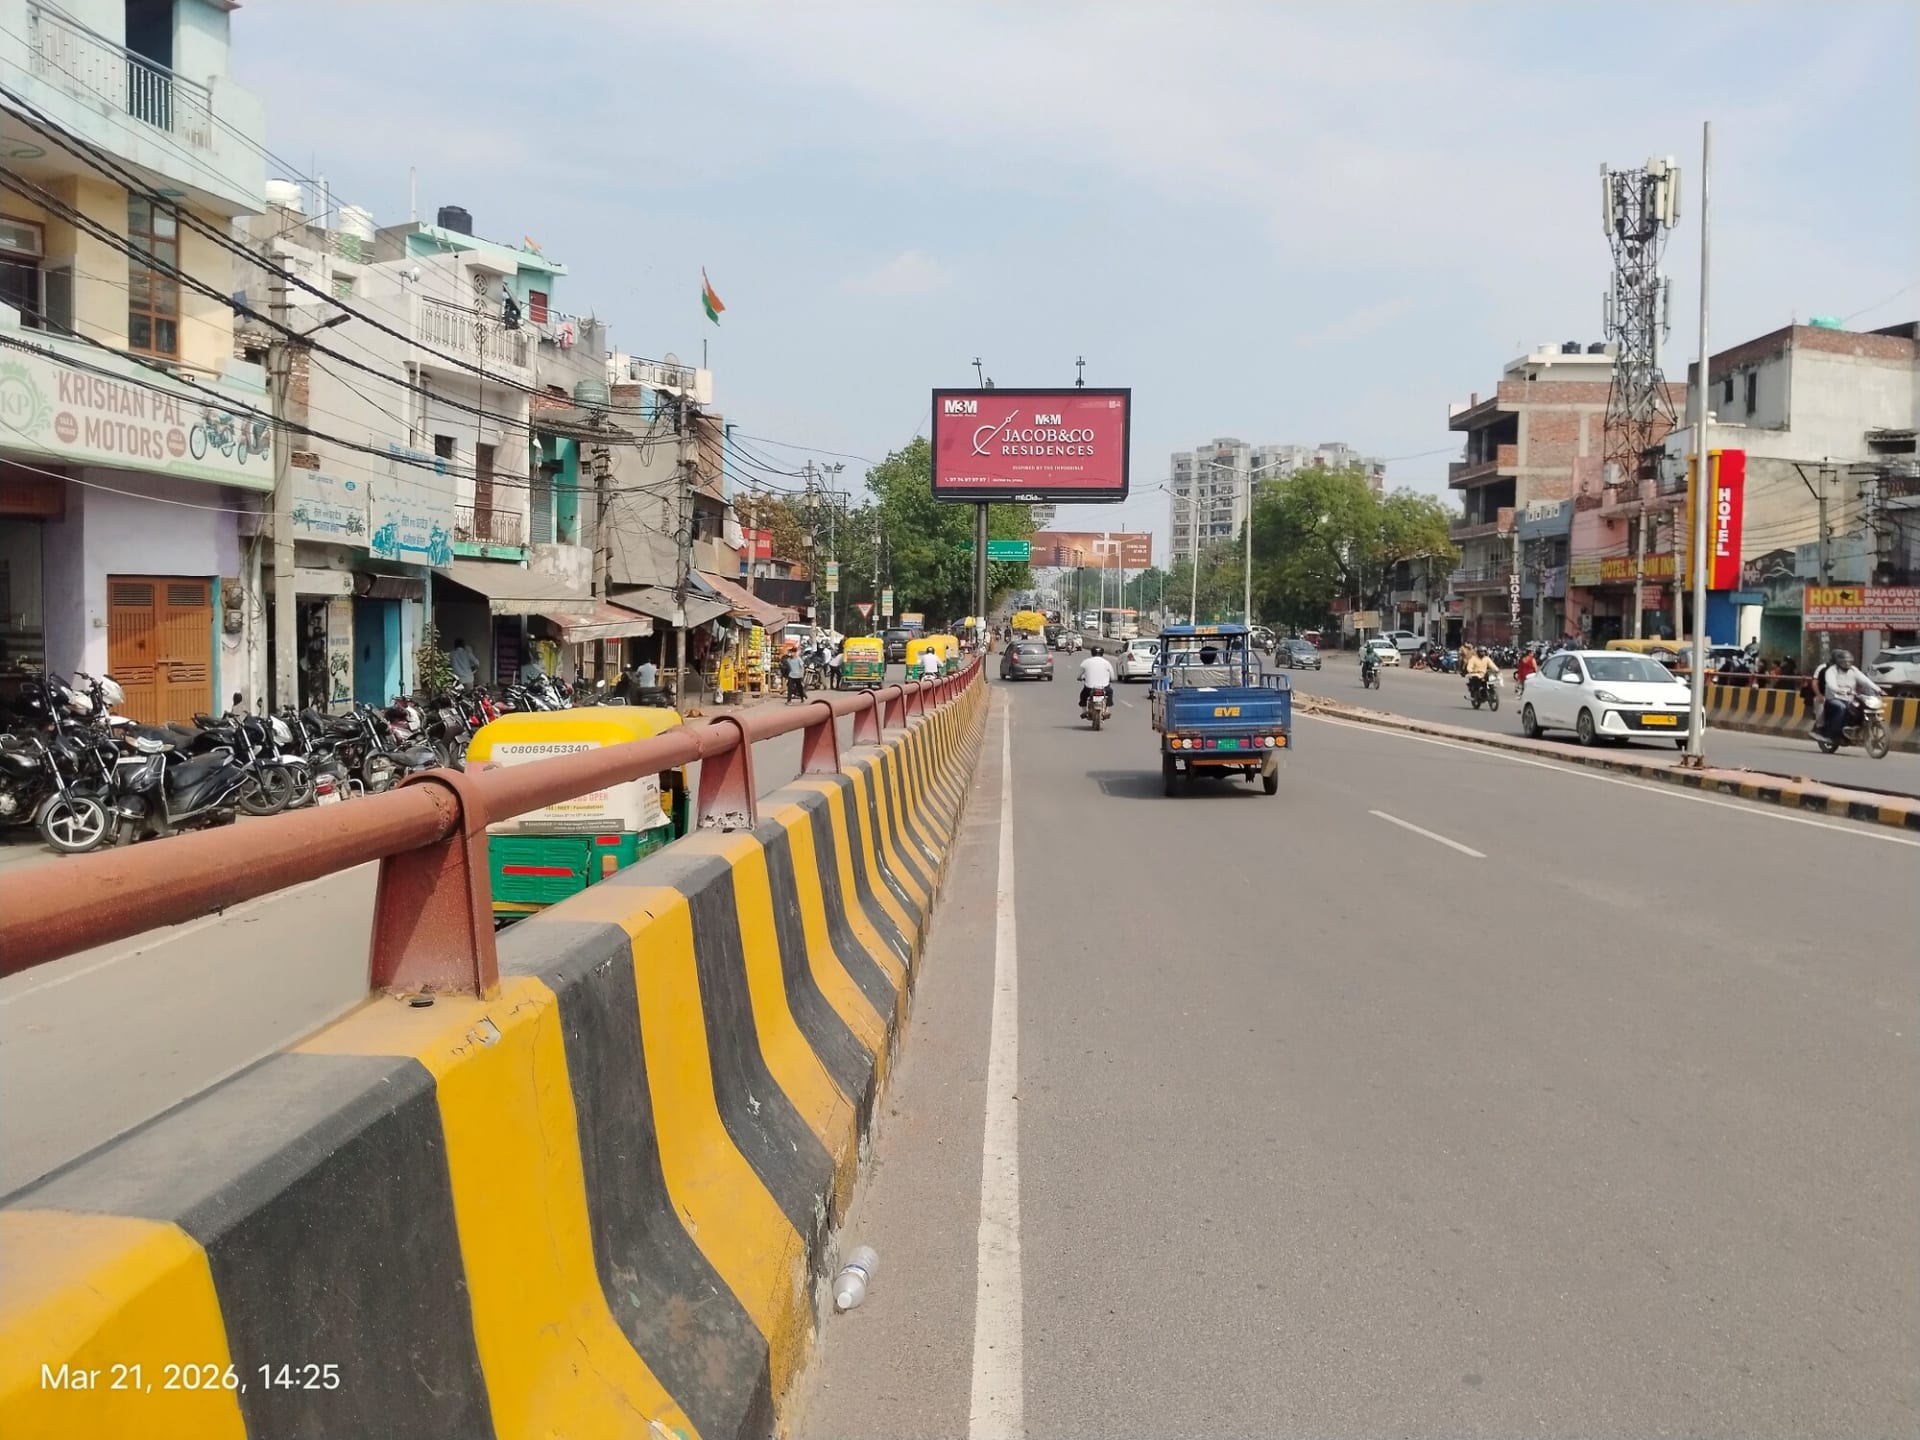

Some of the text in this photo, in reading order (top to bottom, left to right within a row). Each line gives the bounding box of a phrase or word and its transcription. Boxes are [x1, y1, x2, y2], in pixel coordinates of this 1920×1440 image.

[58, 370, 186, 427] KRISHAN PAL
[944, 400, 978, 413] M3M
[1035, 414, 1061, 425] M3M
[85, 415, 164, 460] MOTORS
[1002, 429, 1095, 443] JACOB&CO
[1002, 445, 1094, 456] RESIDENCES
[1716, 487, 1732, 557] HOTEL
[1509, 574, 1521, 622] HOTEL
[1810, 589, 1863, 606] HOTEL
[510, 744, 589, 754] 08069453340
